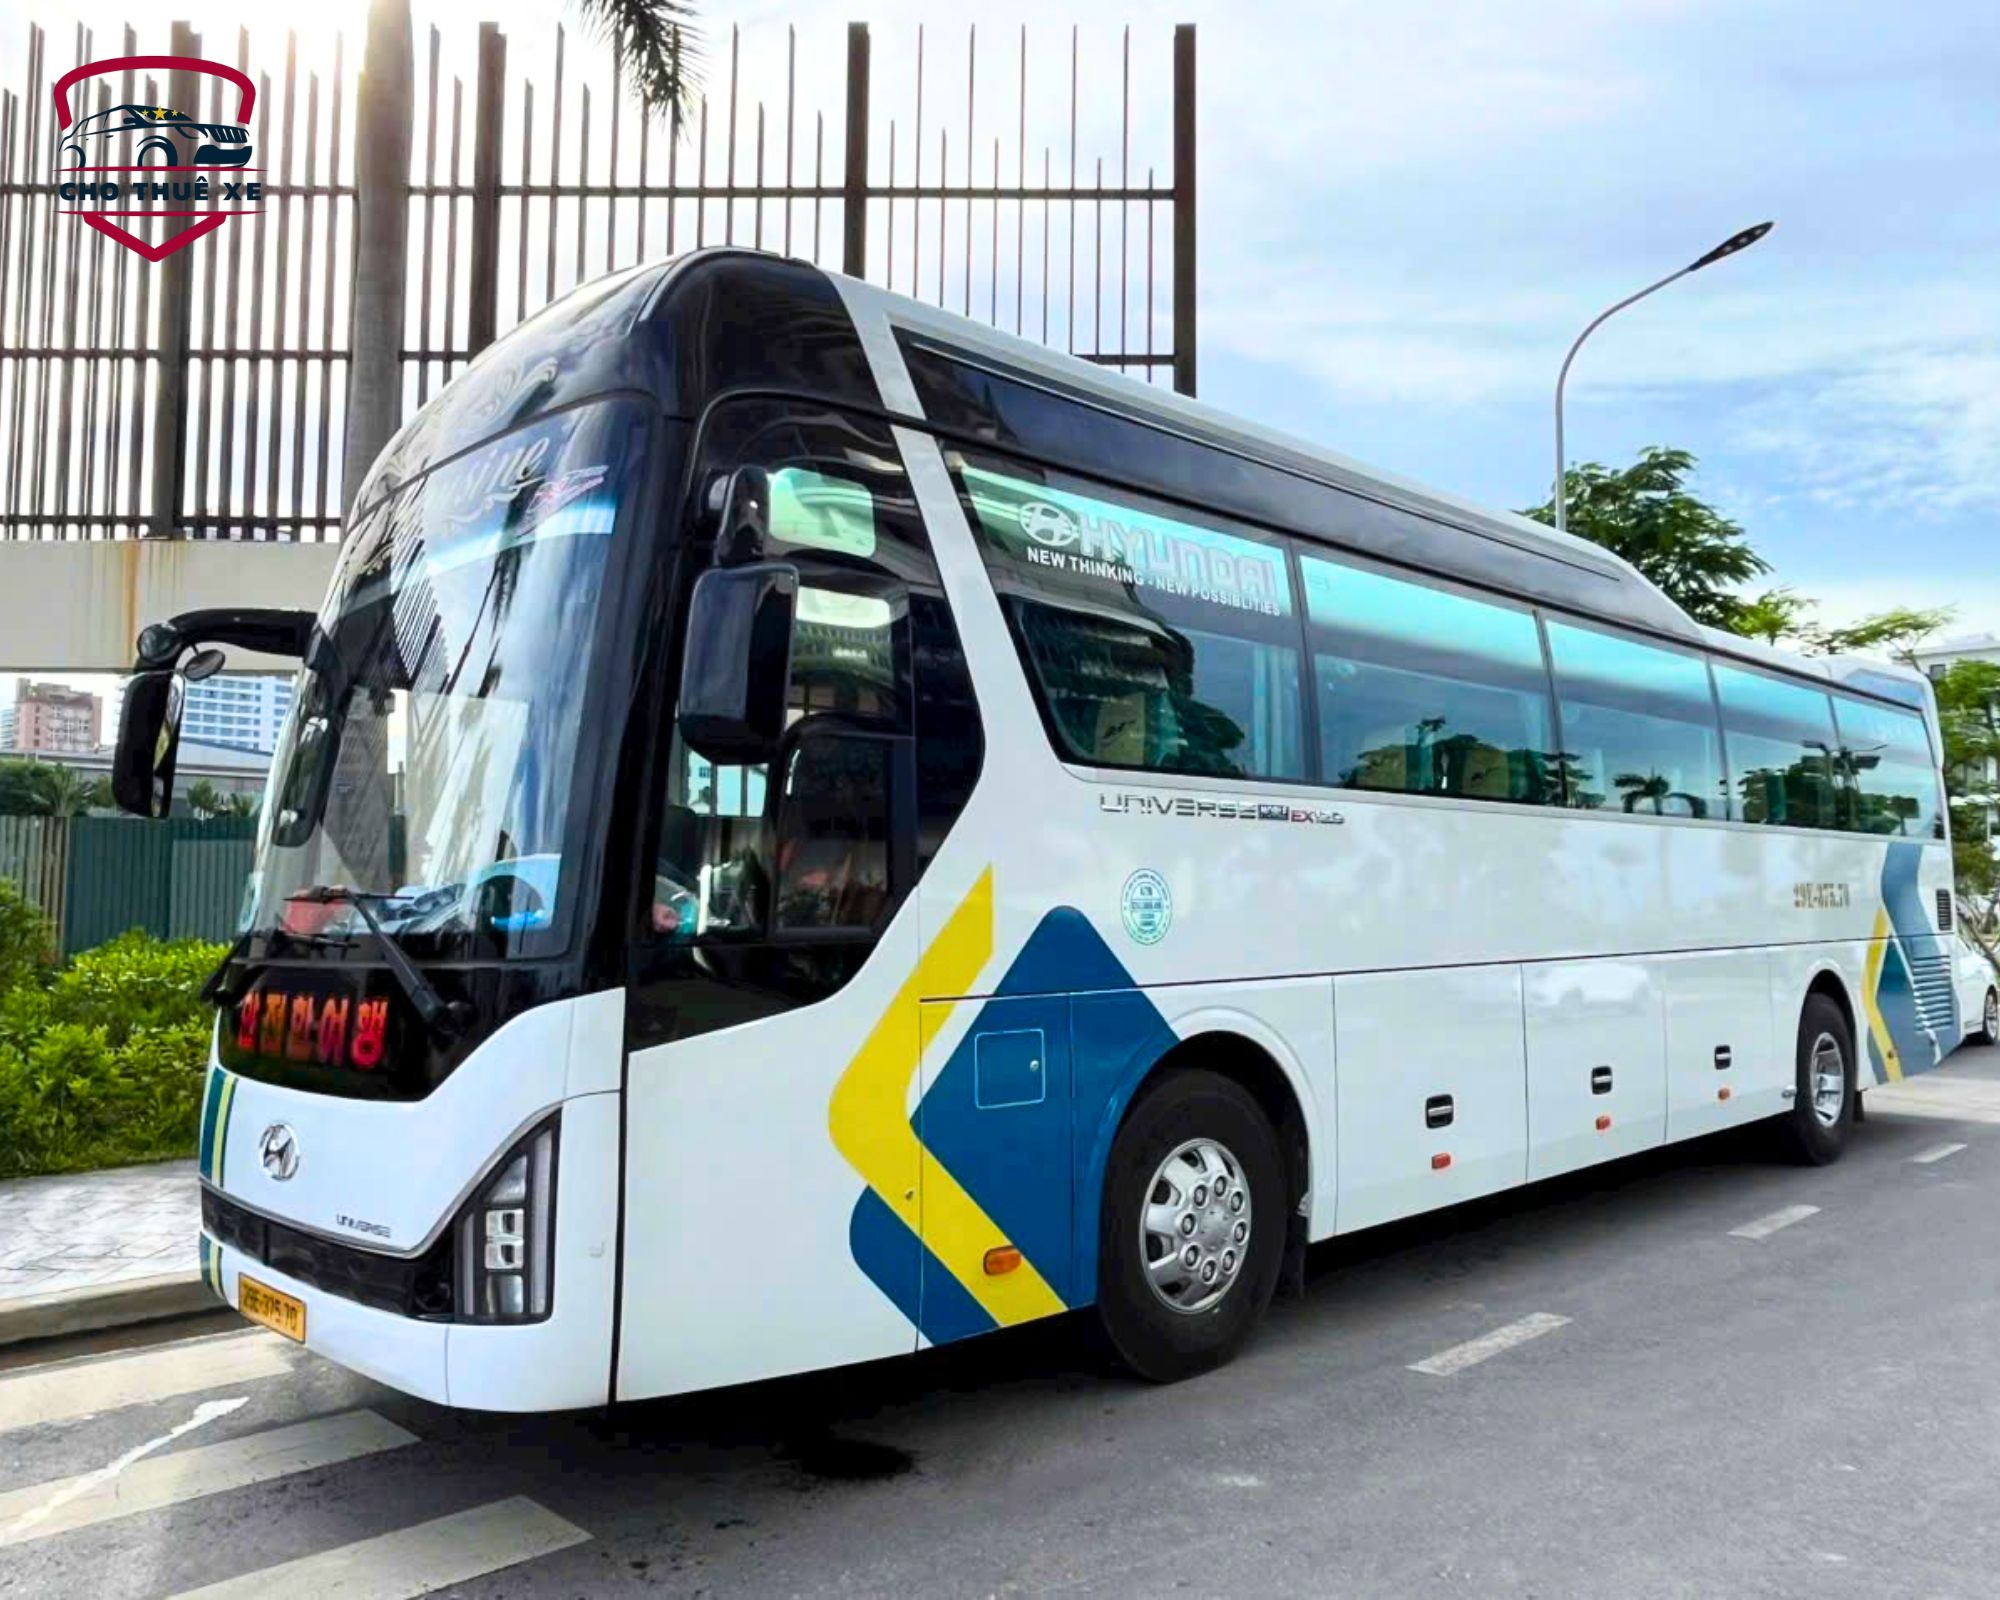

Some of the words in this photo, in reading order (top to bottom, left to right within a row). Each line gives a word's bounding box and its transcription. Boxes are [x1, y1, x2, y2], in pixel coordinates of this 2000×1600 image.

[1027, 546, 1066, 570] NEW
[1069, 555, 1144, 586] THINKING
[1155, 576, 1188, 597] NEW
[1079, 512, 1279, 598] HYUNDAI
[1099, 793, 1257, 819] UNIVERSE
[336, 1213, 392, 1238] UNIVERSE
